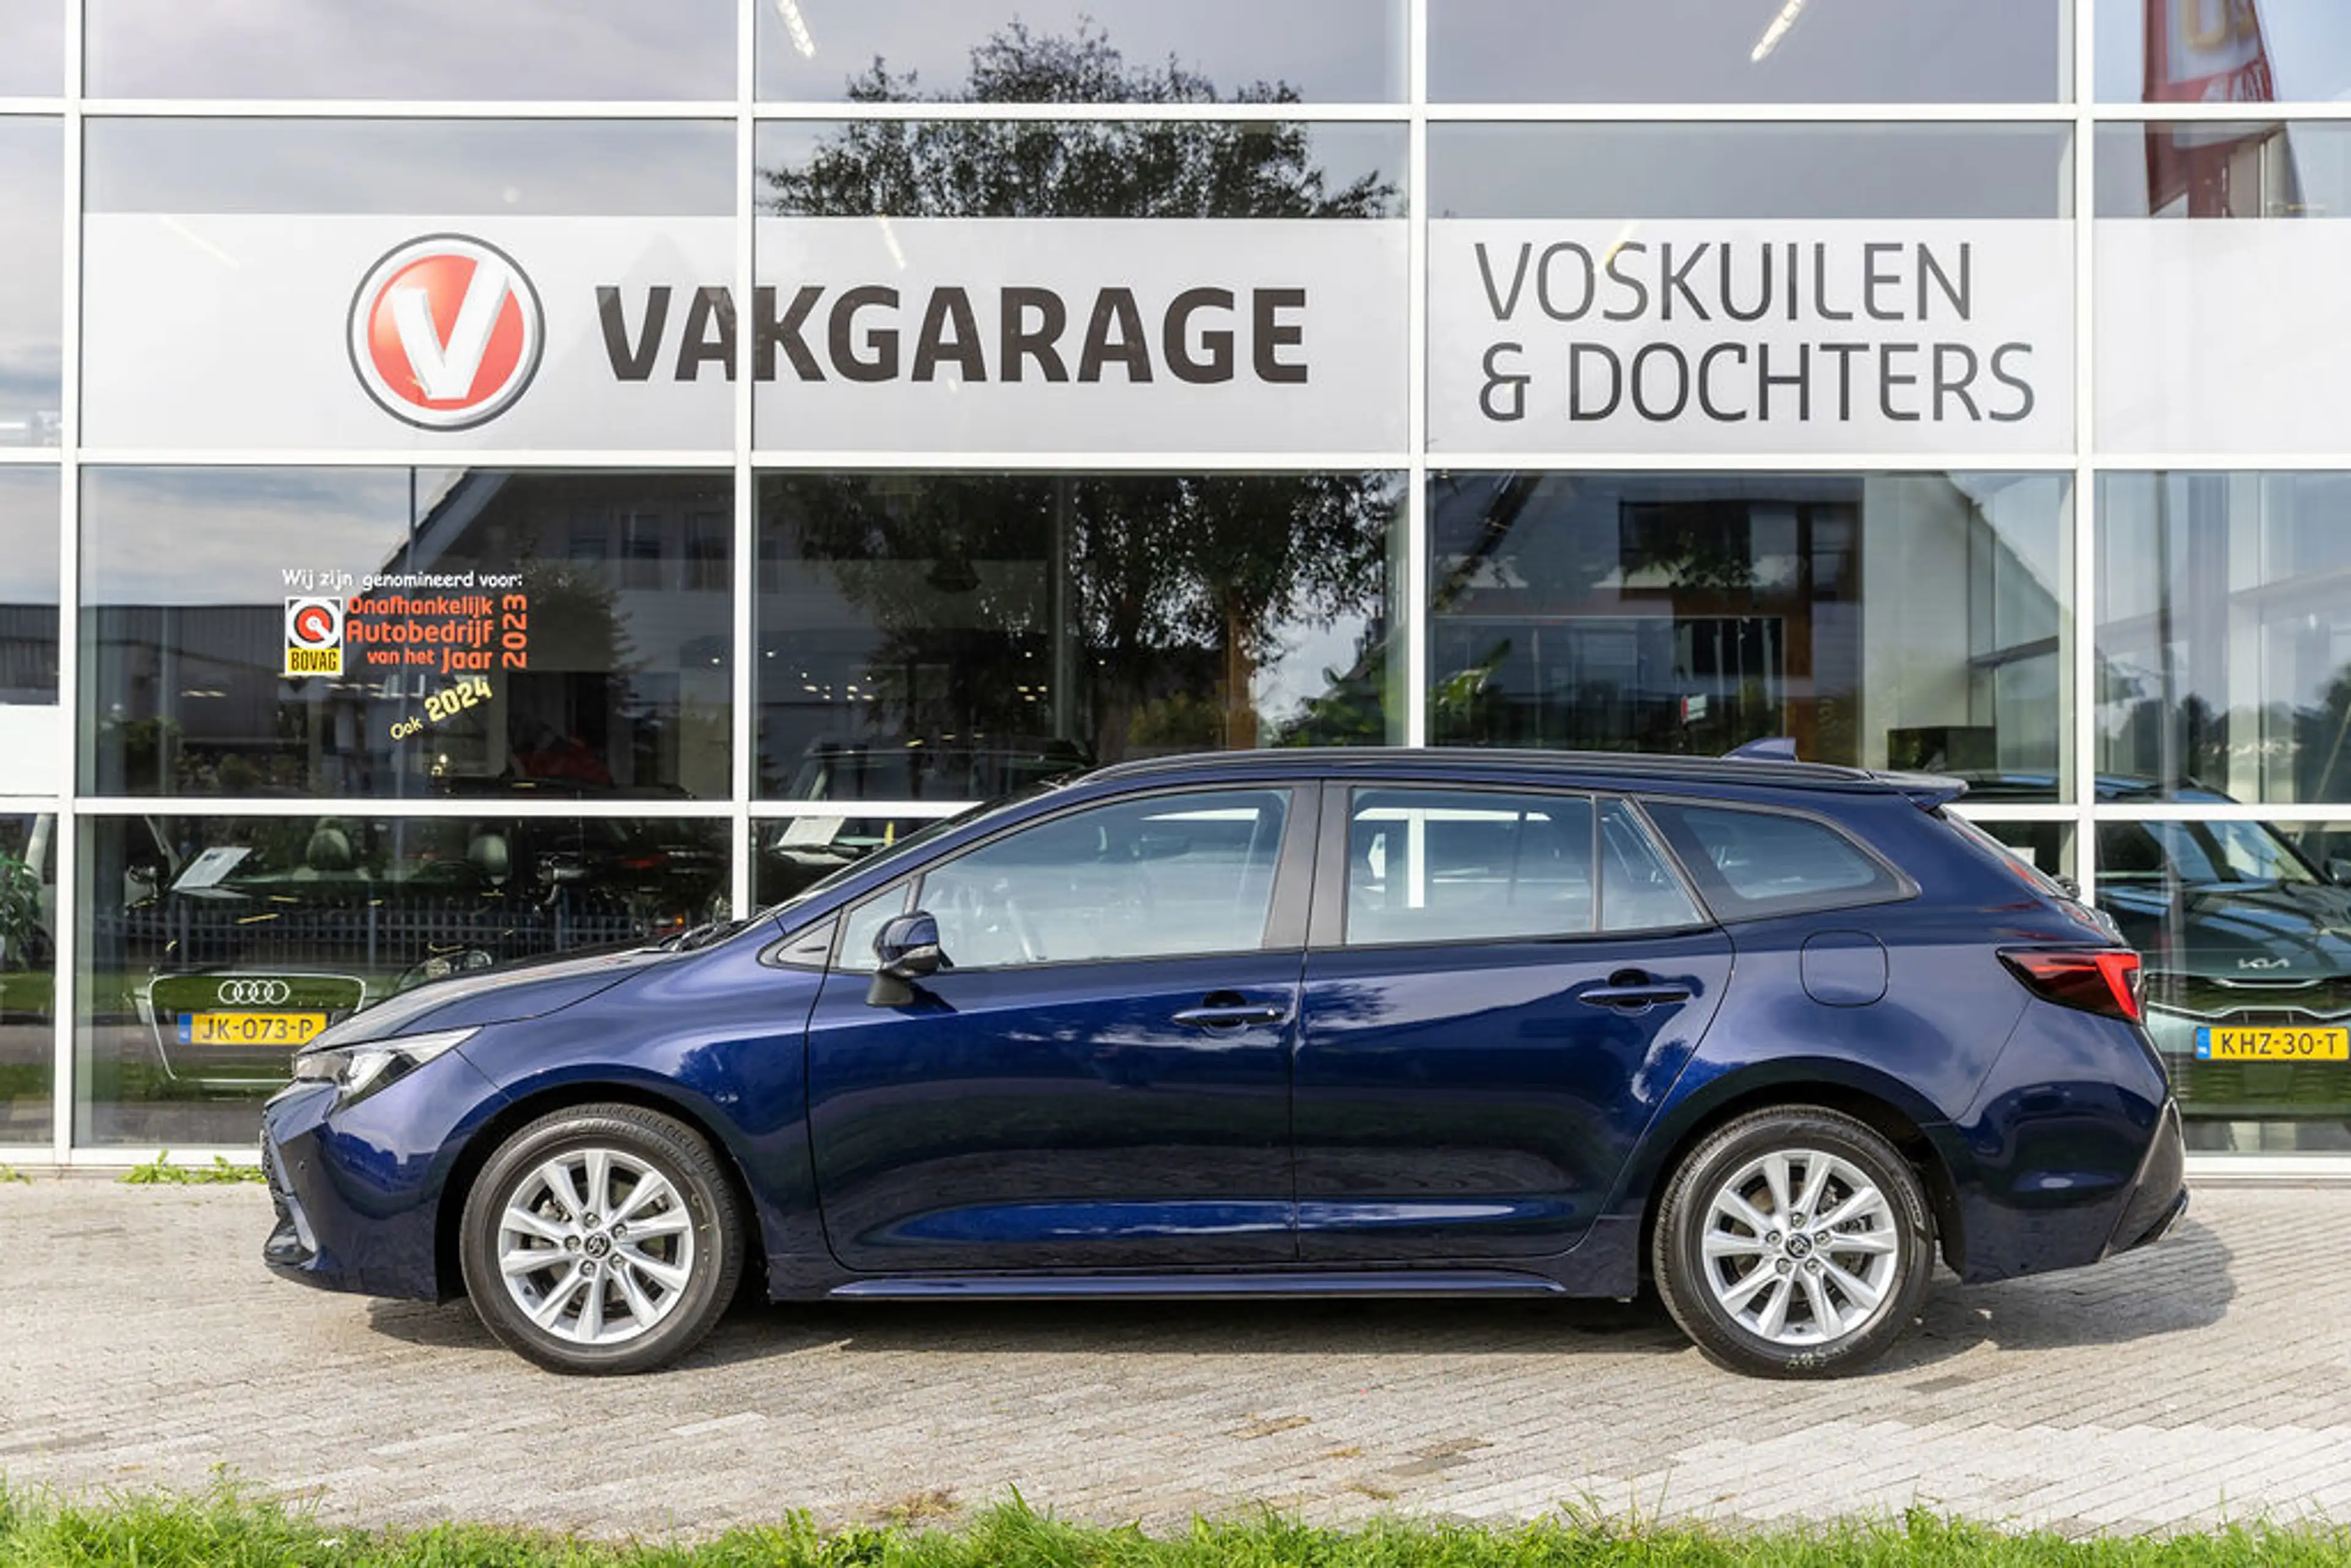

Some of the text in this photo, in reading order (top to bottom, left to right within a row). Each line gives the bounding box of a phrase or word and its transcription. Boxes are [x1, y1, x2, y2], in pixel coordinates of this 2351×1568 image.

[1474, 241, 1971, 321] VOSKUILEN
[595, 285, 1308, 384] VAKGARAGE
[1479, 342, 2036, 422] & DOCHTERS
[282, 569, 523, 591] Wij zijn genomineerd voor:
[348, 595, 493, 618] Onafhankelijk
[347, 620, 494, 647] Autobedrijf
[501, 593, 527, 669] 2023
[290, 650, 337, 672] BOVAG
[367, 649, 493, 674] van het Jaar
[390, 677, 493, 740] Ook 2024
[201, 1018, 313, 1040] JK-073-P
[2221, 1033, 2338, 1054] KHZ-30-T
